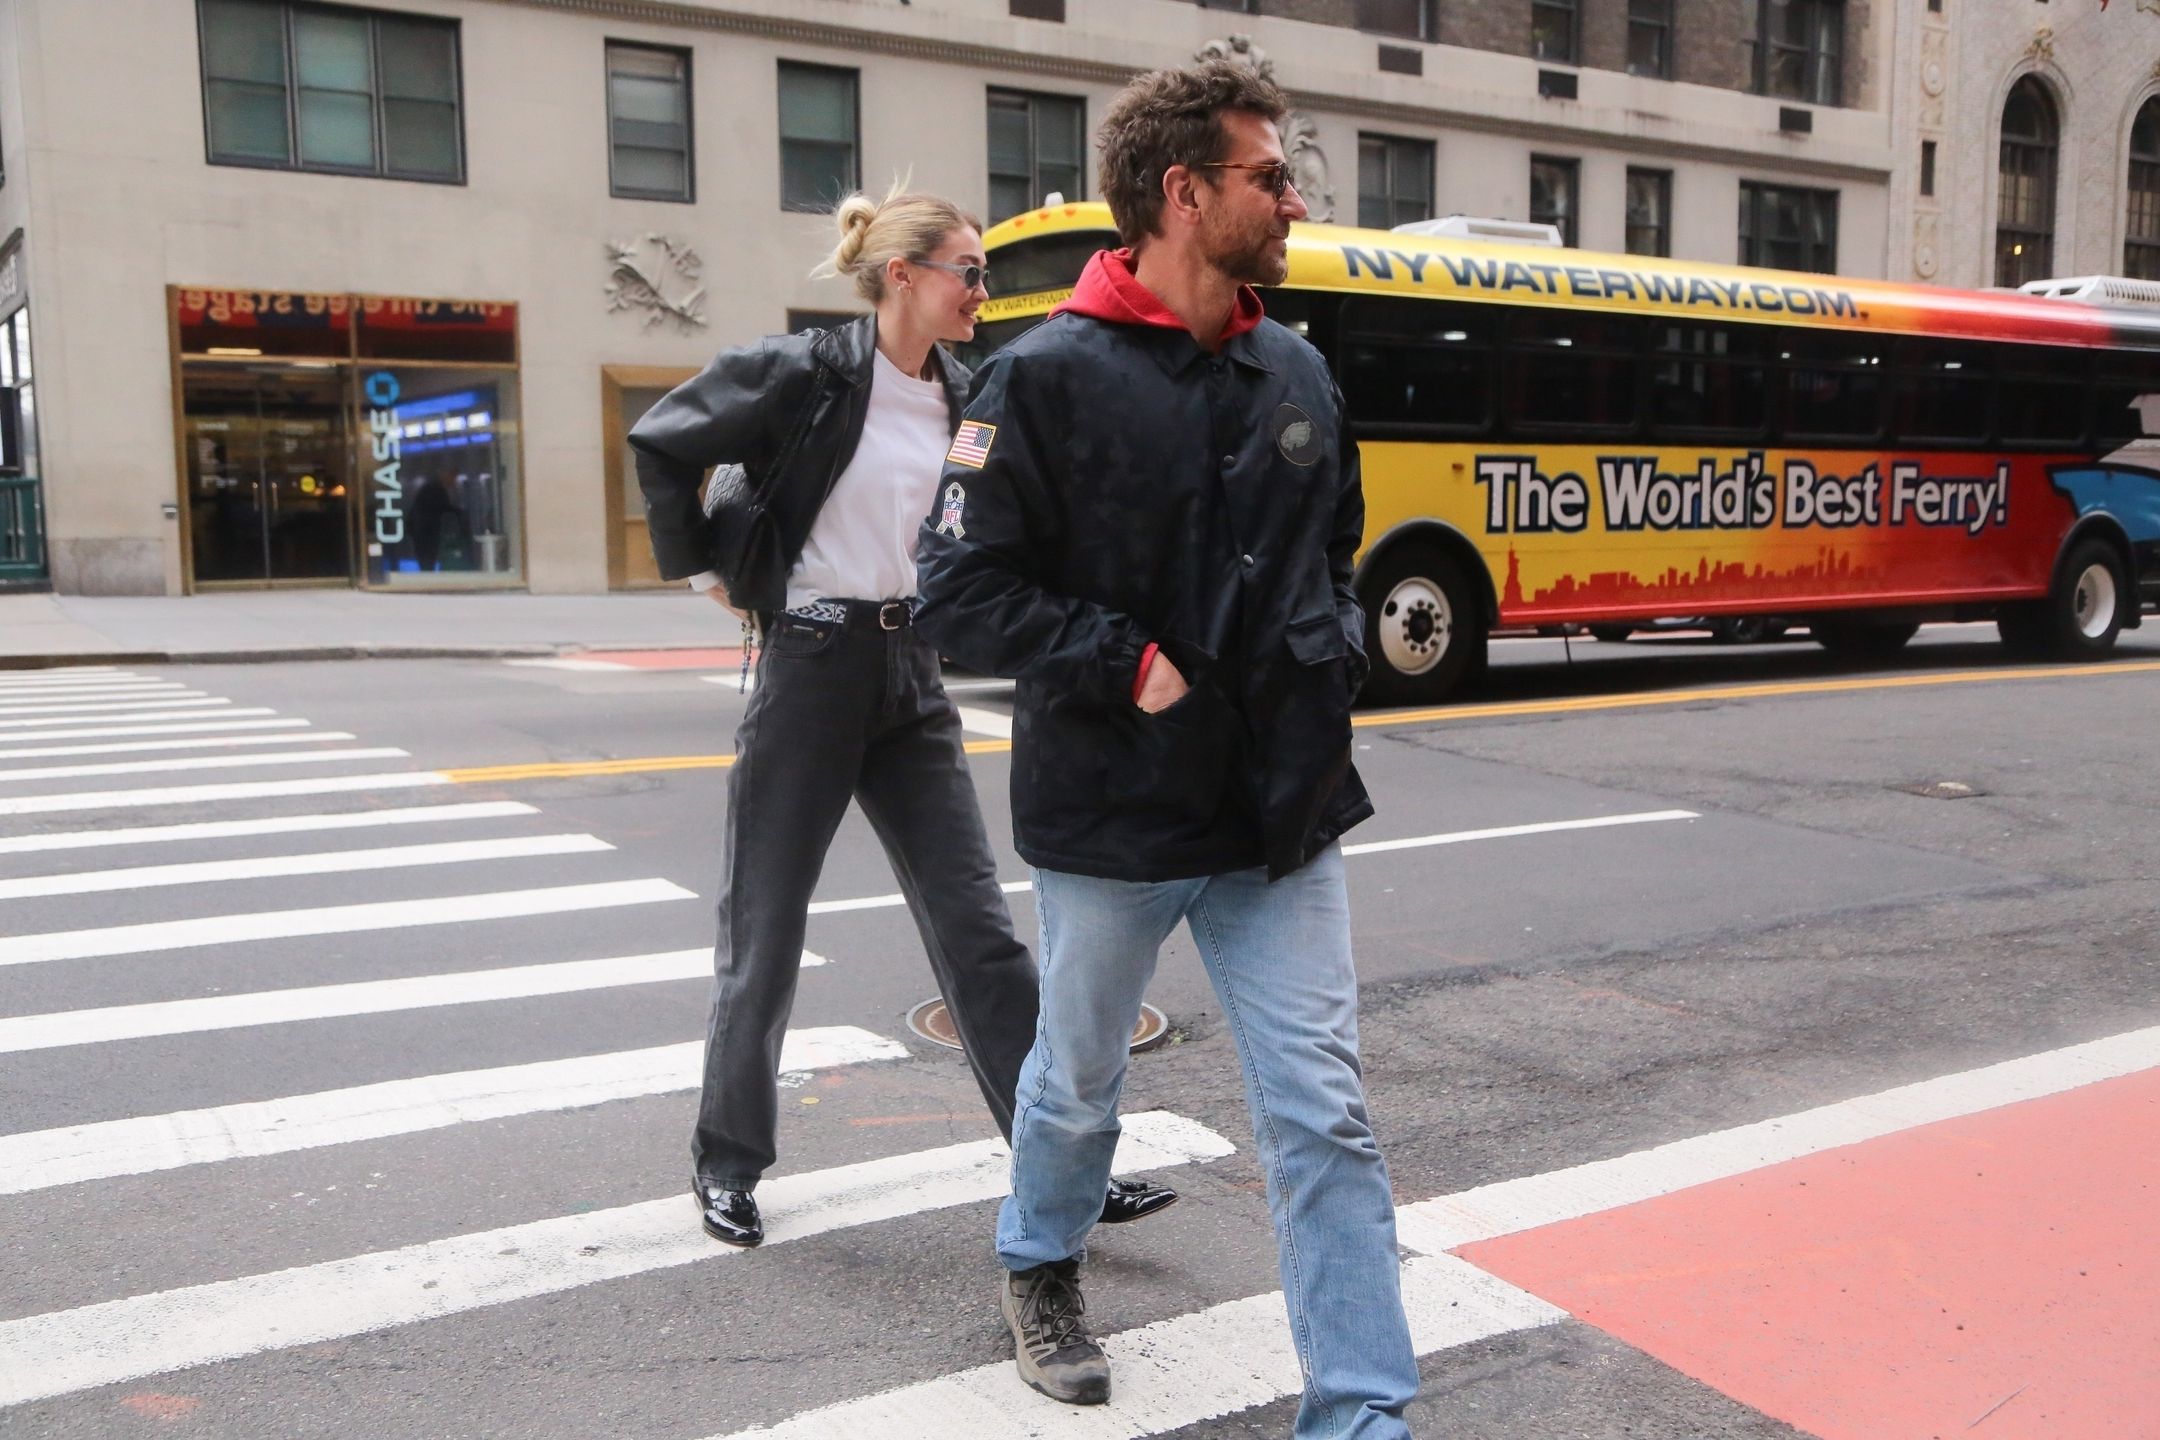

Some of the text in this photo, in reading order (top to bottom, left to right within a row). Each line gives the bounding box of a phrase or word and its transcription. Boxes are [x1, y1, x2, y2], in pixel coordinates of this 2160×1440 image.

[1341, 246, 1429, 283] NY
[984, 302, 1001, 313] NY
[370, 408, 404, 543] CHASE
[1475, 451, 2009, 536] The World's Best Ferry!
[944, 510, 959, 521] NFL
